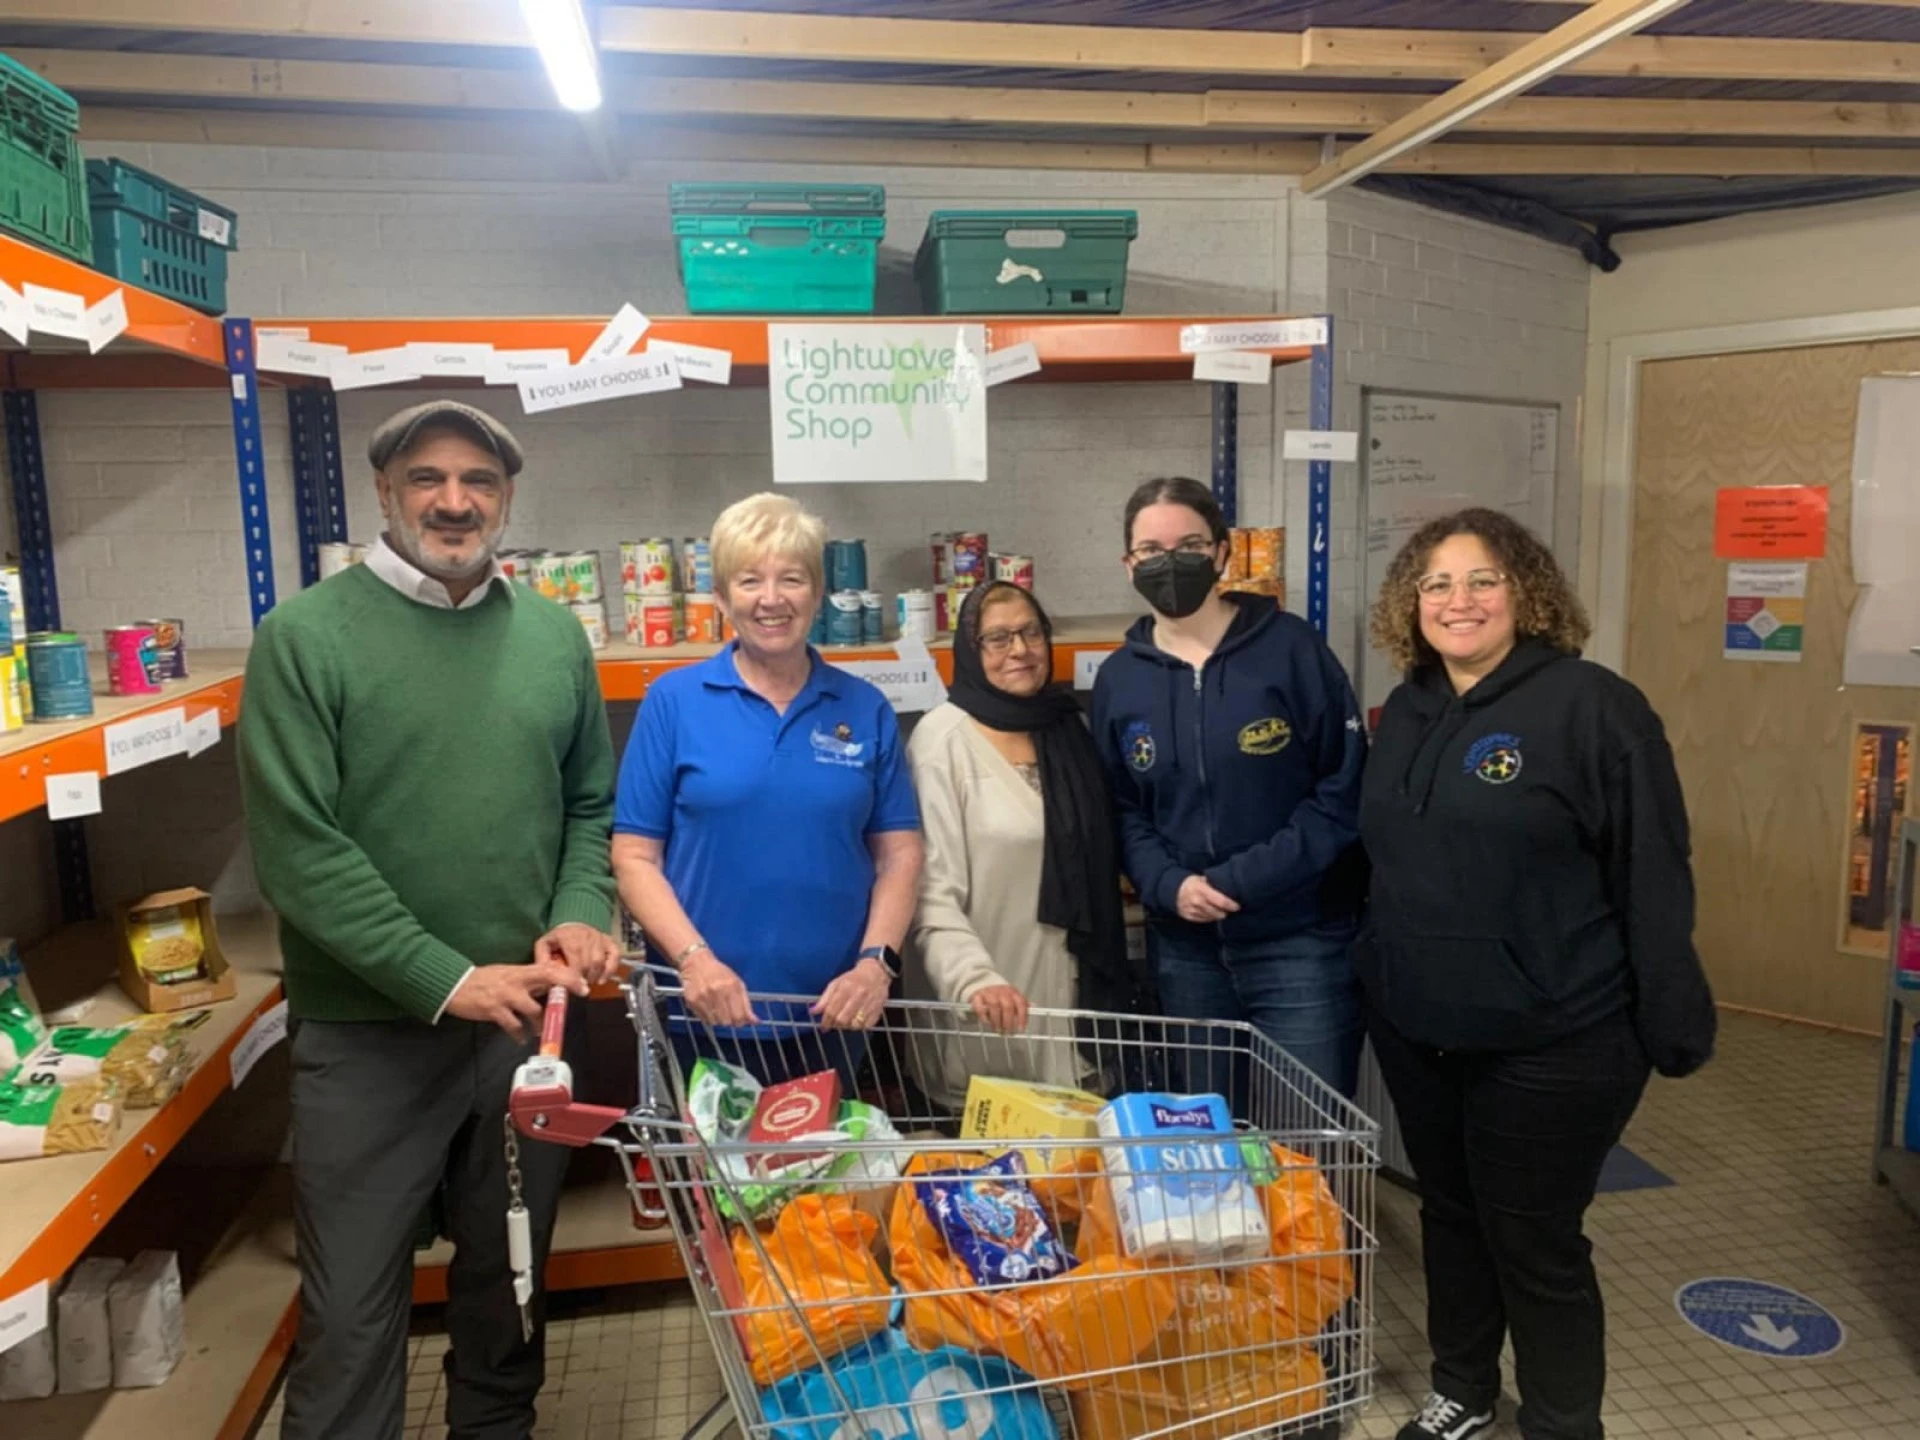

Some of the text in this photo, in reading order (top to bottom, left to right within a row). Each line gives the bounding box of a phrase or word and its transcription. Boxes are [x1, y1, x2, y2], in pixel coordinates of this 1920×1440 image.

[1239, 332, 1280, 345] CHOOSE
[784, 337, 957, 379] Lightwave
[538, 382, 566, 399] YOU
[569, 376, 598, 393] MAY
[601, 367, 651, 387] CHOOSE
[785, 373, 971, 413] Community
[786, 408, 873, 448] Shop
[864, 671, 909, 684] CHOOSE
